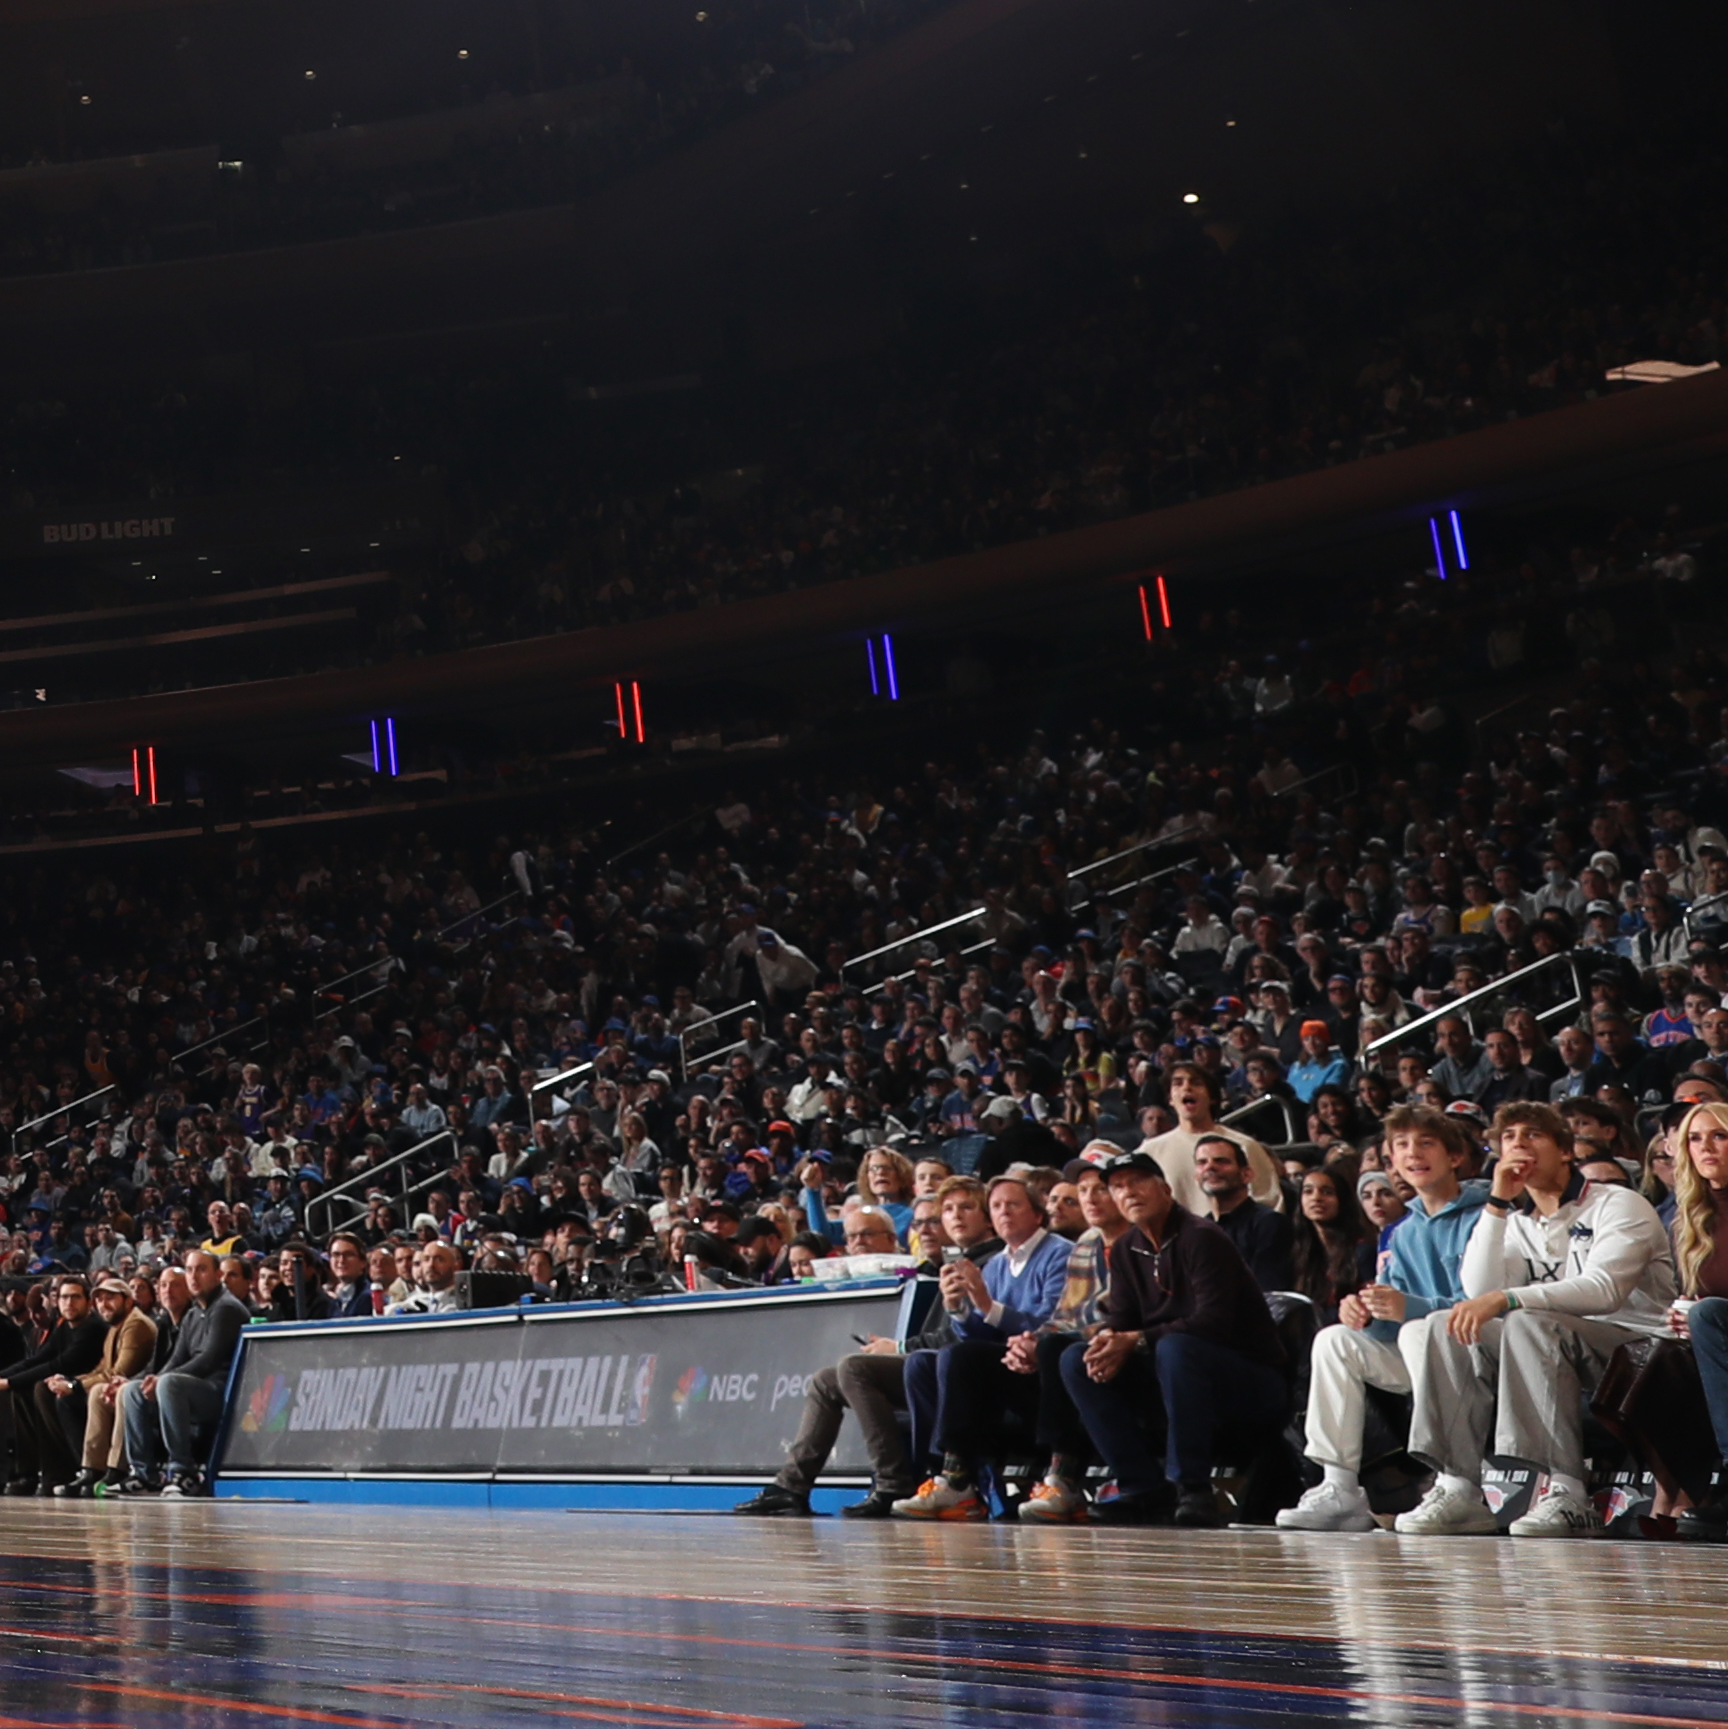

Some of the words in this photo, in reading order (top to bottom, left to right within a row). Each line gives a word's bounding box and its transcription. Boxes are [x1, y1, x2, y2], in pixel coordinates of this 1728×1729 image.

[44, 523, 97, 543] BUD
[101, 517, 175, 539] LIGHT
[288, 1367, 385, 1432] SUNDAY
[379, 1363, 459, 1430] NIGHT
[451, 1354, 630, 1430] BASKETBALL
[708, 1374, 758, 1403] NBC
